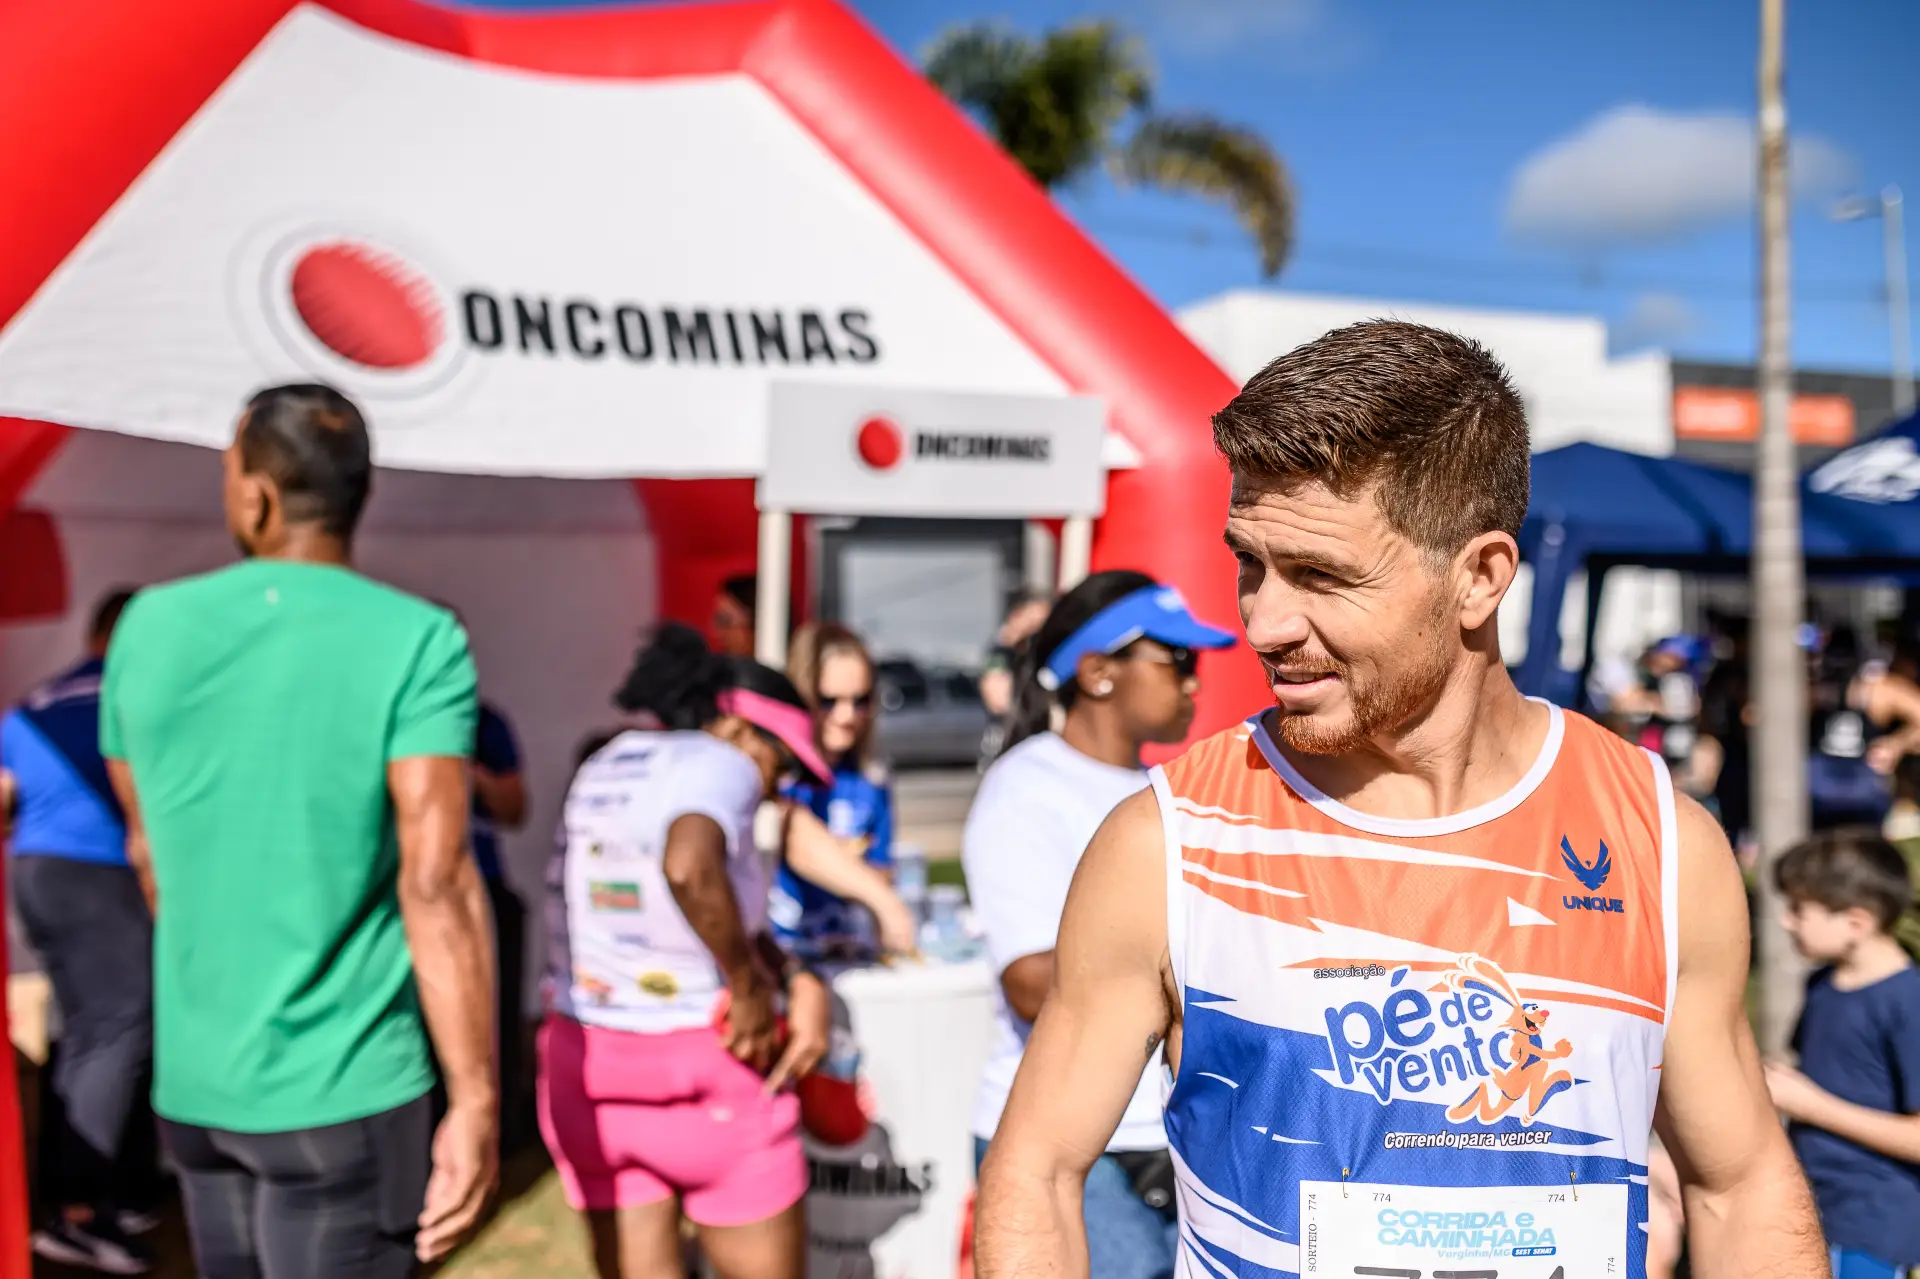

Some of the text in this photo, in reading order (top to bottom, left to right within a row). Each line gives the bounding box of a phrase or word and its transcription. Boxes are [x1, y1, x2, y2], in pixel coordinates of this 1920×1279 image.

[462, 291, 878, 364] ONCOMINAS
[1563, 896, 1624, 913] UNIQUE
[1313, 964, 1386, 979] associação
[1324, 968, 1493, 1085] pé de
[1384, 1130, 1552, 1150] Correndo para vencer
[1308, 1193, 1317, 1211] 774
[1372, 1192, 1391, 1203] 774
[1548, 1194, 1565, 1203] 774
[1378, 1208, 1535, 1229] CORRIDA e
[1378, 1228, 1557, 1249] CAMINHADA
[1308, 1223, 1317, 1272] SORTEIO
[1438, 1248, 1511, 1261] Varginha/MG
[1532, 1248, 1553, 1256] SENAT
[1607, 1257, 1616, 1274] 774
